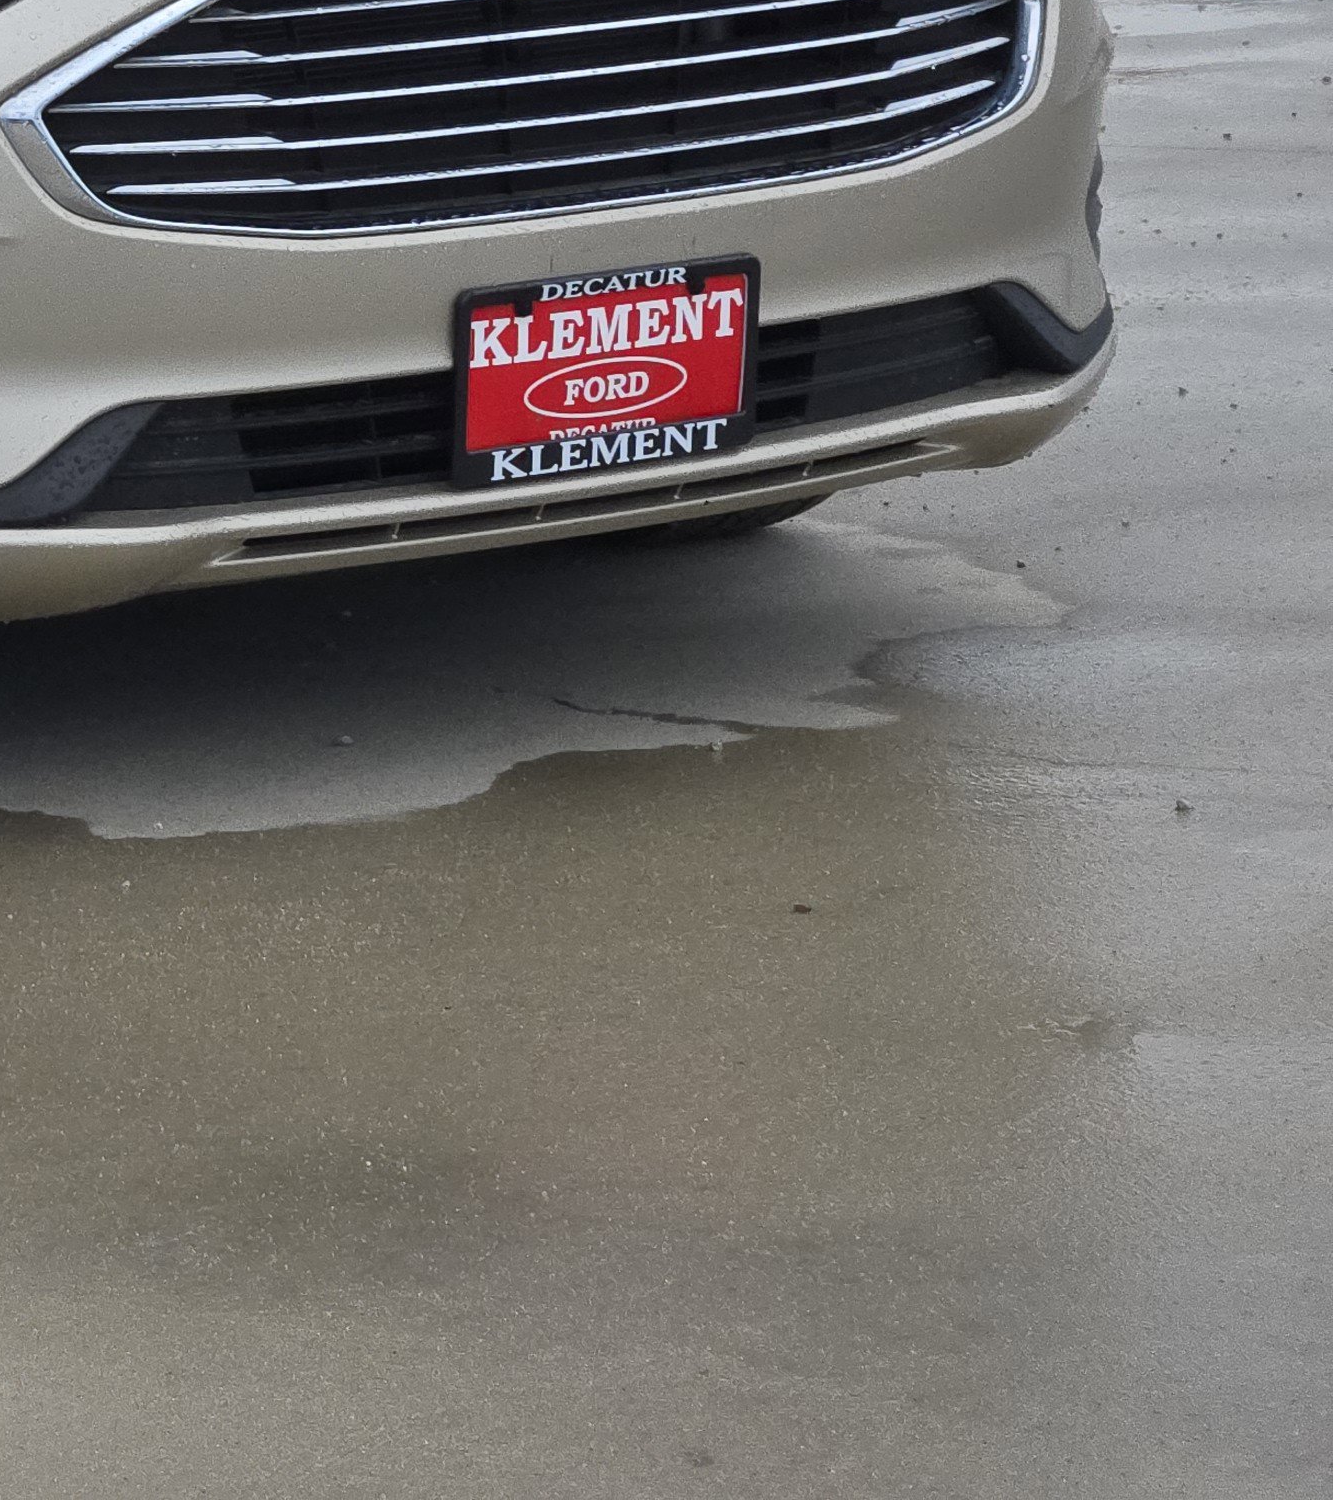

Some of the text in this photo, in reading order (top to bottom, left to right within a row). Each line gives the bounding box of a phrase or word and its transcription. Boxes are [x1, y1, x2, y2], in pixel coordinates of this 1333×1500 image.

[540, 266, 687, 302] DECATUR
[469, 287, 744, 370] KLEMENT
[563, 370, 650, 407] FORD
[490, 417, 728, 482] KLEMENT
